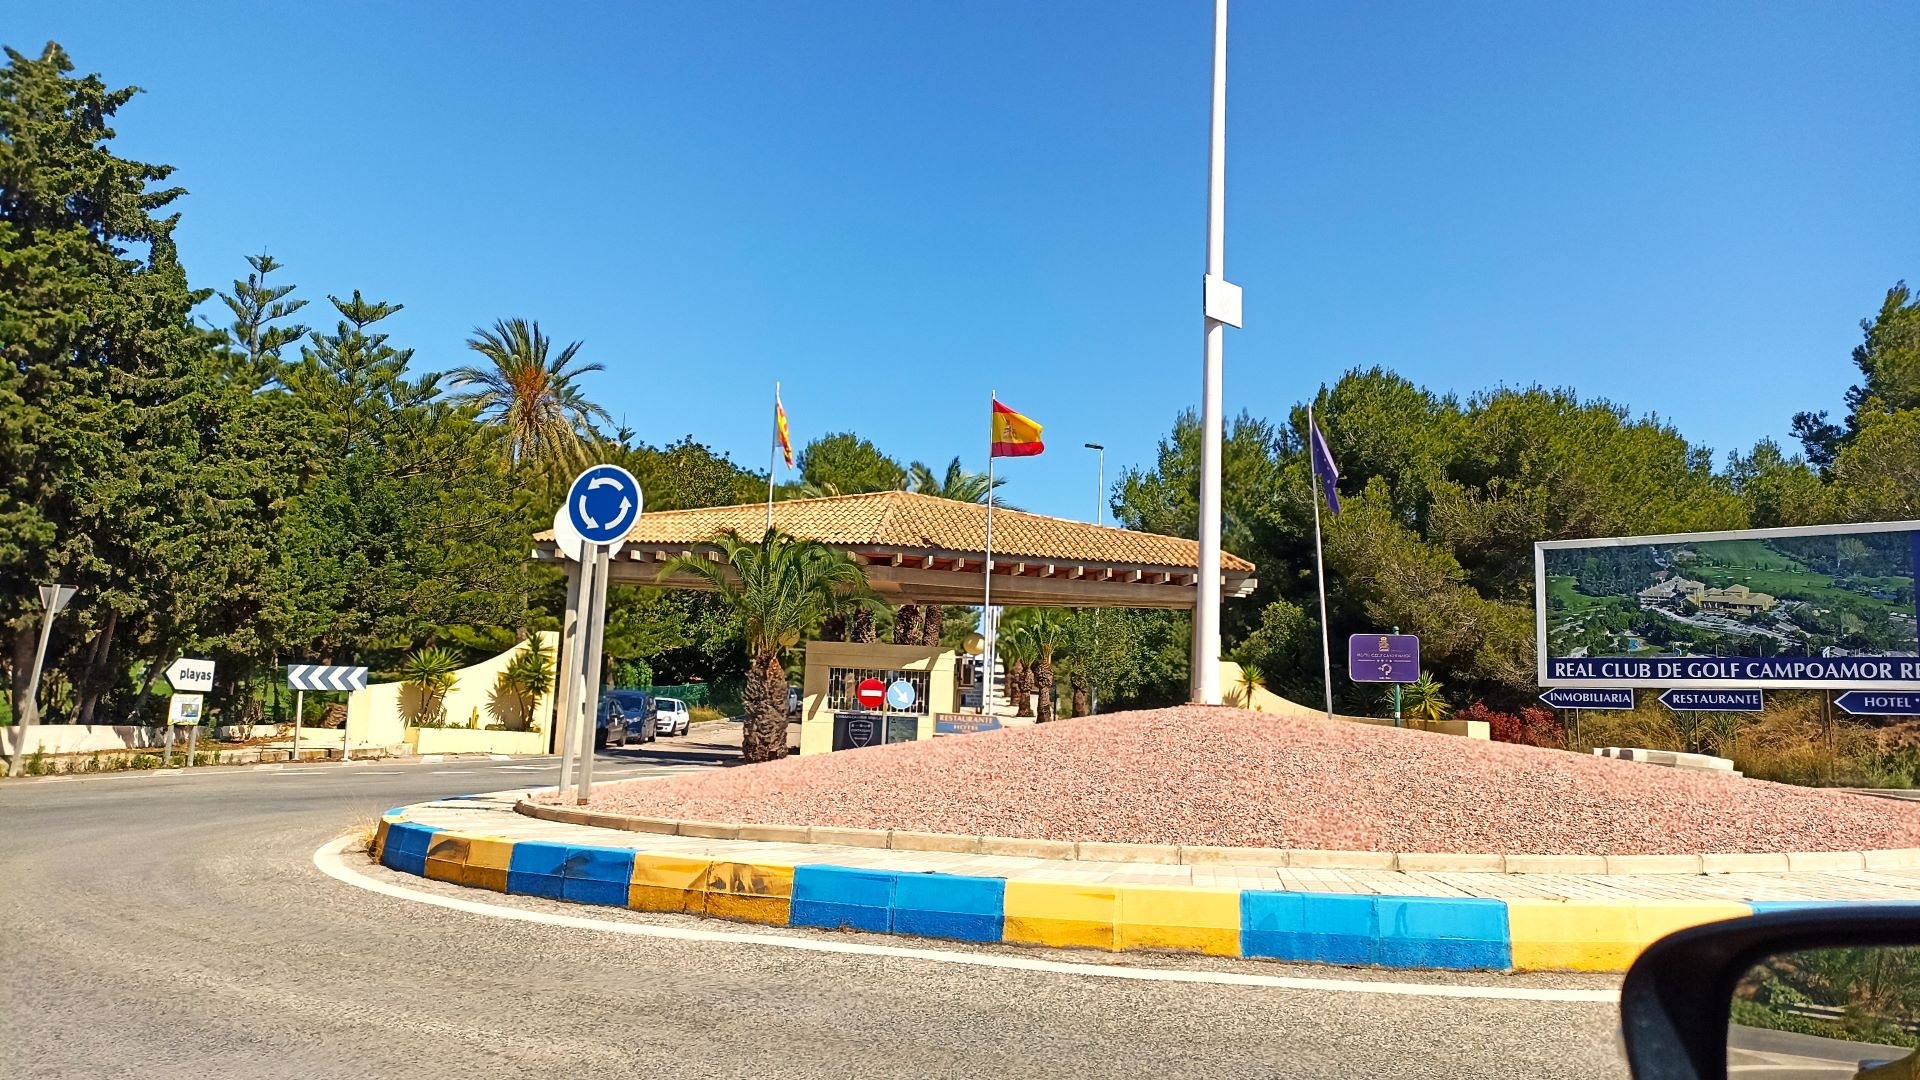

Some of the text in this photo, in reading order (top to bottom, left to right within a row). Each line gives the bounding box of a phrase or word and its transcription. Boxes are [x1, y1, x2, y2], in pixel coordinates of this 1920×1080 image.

[180, 668, 212, 681] playas
[1555, 662, 1597, 678] REAL
[1601, 662, 1651, 678] CLUB
[1657, 662, 1682, 678] DE
[1687, 662, 1740, 678] GOLF
[1746, 662, 1893, 679] CAMPOAMOR
[1550, 692, 1631, 703] INMOBILIARIA
[1672, 694, 1759, 705] RESTAURANTE
[1864, 697, 1911, 708] HOTEL
